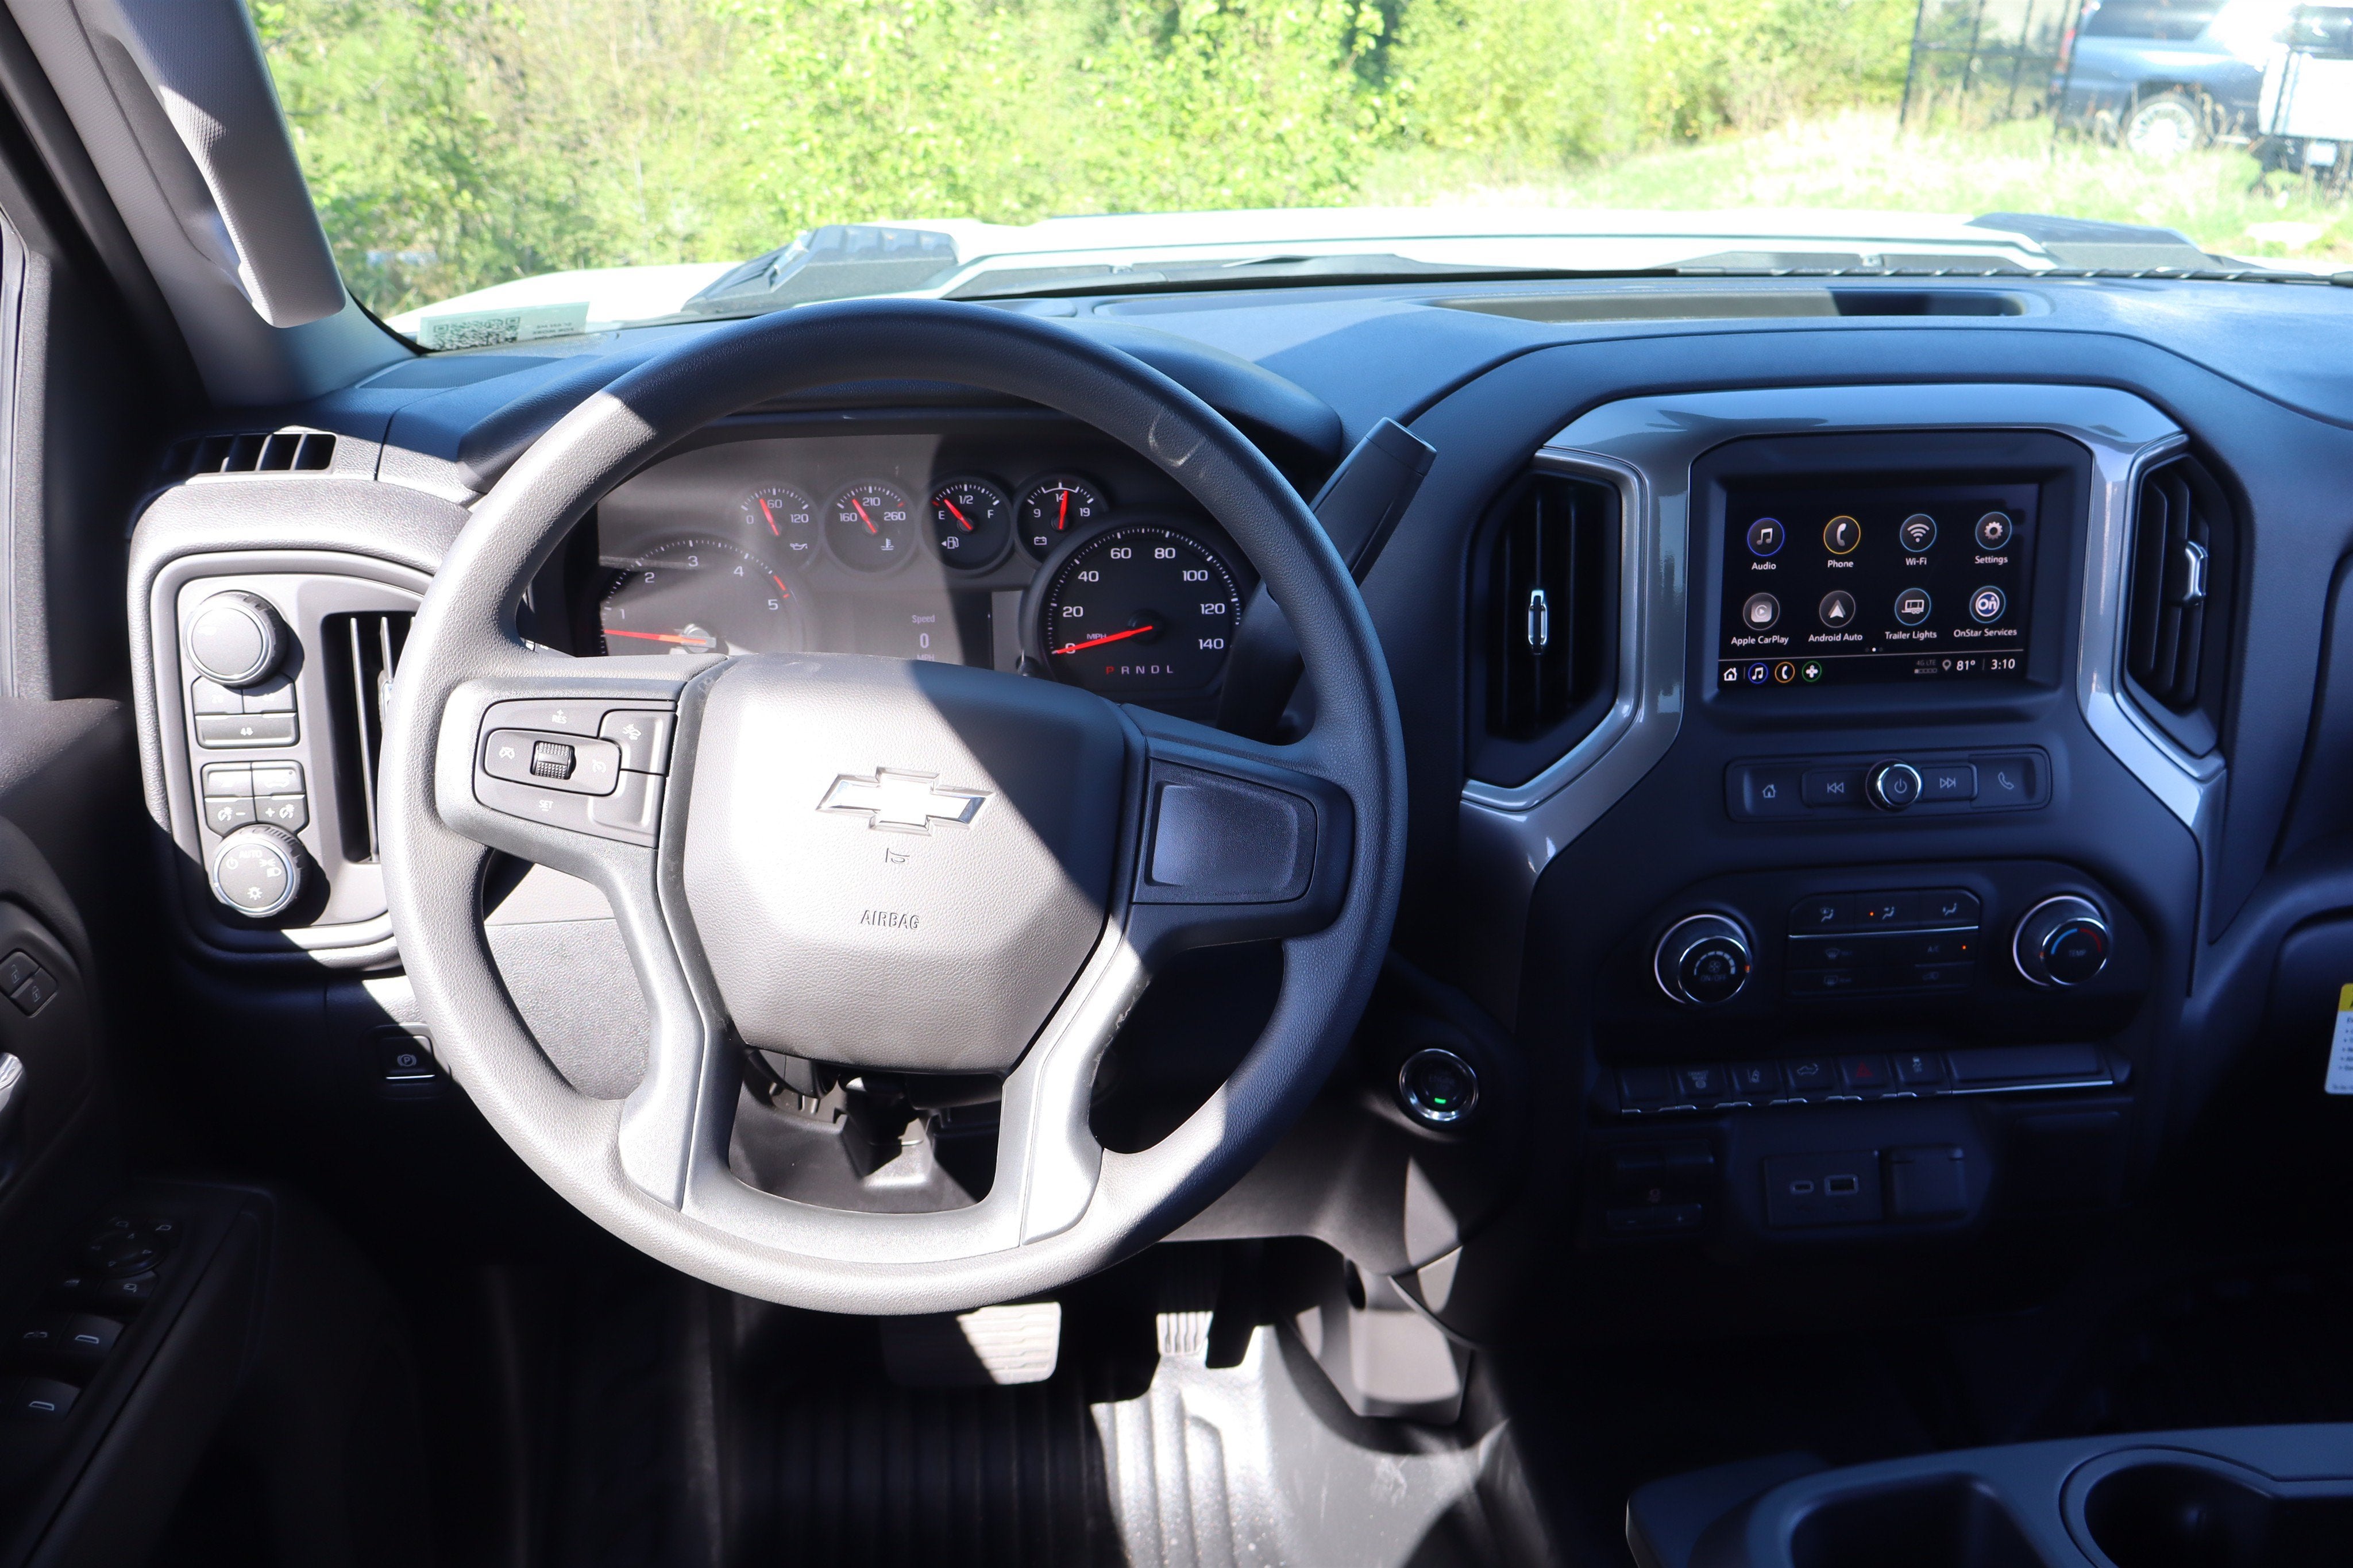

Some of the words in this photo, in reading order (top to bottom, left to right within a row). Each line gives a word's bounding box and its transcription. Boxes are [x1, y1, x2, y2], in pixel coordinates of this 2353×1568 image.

[767, 499, 782, 508] 60
[862, 497, 881, 506] 210
[959, 495, 974, 504] 1/2
[839, 512, 858, 522] 160
[884, 511, 906, 521] 260
[938, 510, 946, 520] E
[987, 509, 994, 519] F
[1033, 509, 1041, 517] 9
[1079, 507, 1090, 517] 19
[746, 515, 754, 524] 0
[790, 513, 809, 523] 120
[1110, 547, 1132, 559] 60
[1154, 547, 1176, 559] 80
[688, 555, 699, 567] 3
[1827, 559, 1854, 568] Phone
[1905, 557, 1927, 566] Wi-Fi
[1974, 555, 2008, 566] Settings
[1752, 562, 1777, 570] Audio
[734, 566, 744, 577] 4
[1078, 571, 1100, 582] 40
[1182, 570, 1208, 581] 100
[645, 571, 655, 583] 2
[768, 599, 779, 611] 5
[1200, 603, 1225, 615] 120
[619, 609, 626, 620] 1
[1063, 606, 1083, 617] 20
[912, 615, 936, 624] Speed
[1808, 633, 1842, 642] Android
[1843, 632, 1863, 641] Auto
[1885, 631, 1910, 640] Trailer
[1912, 630, 1937, 641] Lights
[1953, 629, 1982, 638] OnStar
[1984, 628, 2017, 637] Services
[920, 633, 929, 648] 0
[1198, 638, 1224, 650] 140
[1731, 636, 1756, 647] Apple
[1758, 635, 1789, 645] CarPlay
[1991, 658, 2016, 670] 3:10
[1106, 666, 1114, 675] P
[1121, 666, 1130, 674] R
[1136, 666, 1145, 674] N
[1151, 665, 1160, 674] D
[1167, 665, 1174, 673] L
[239, 850, 263, 859] AUTO
[861, 910, 920, 929] AIRBAG
